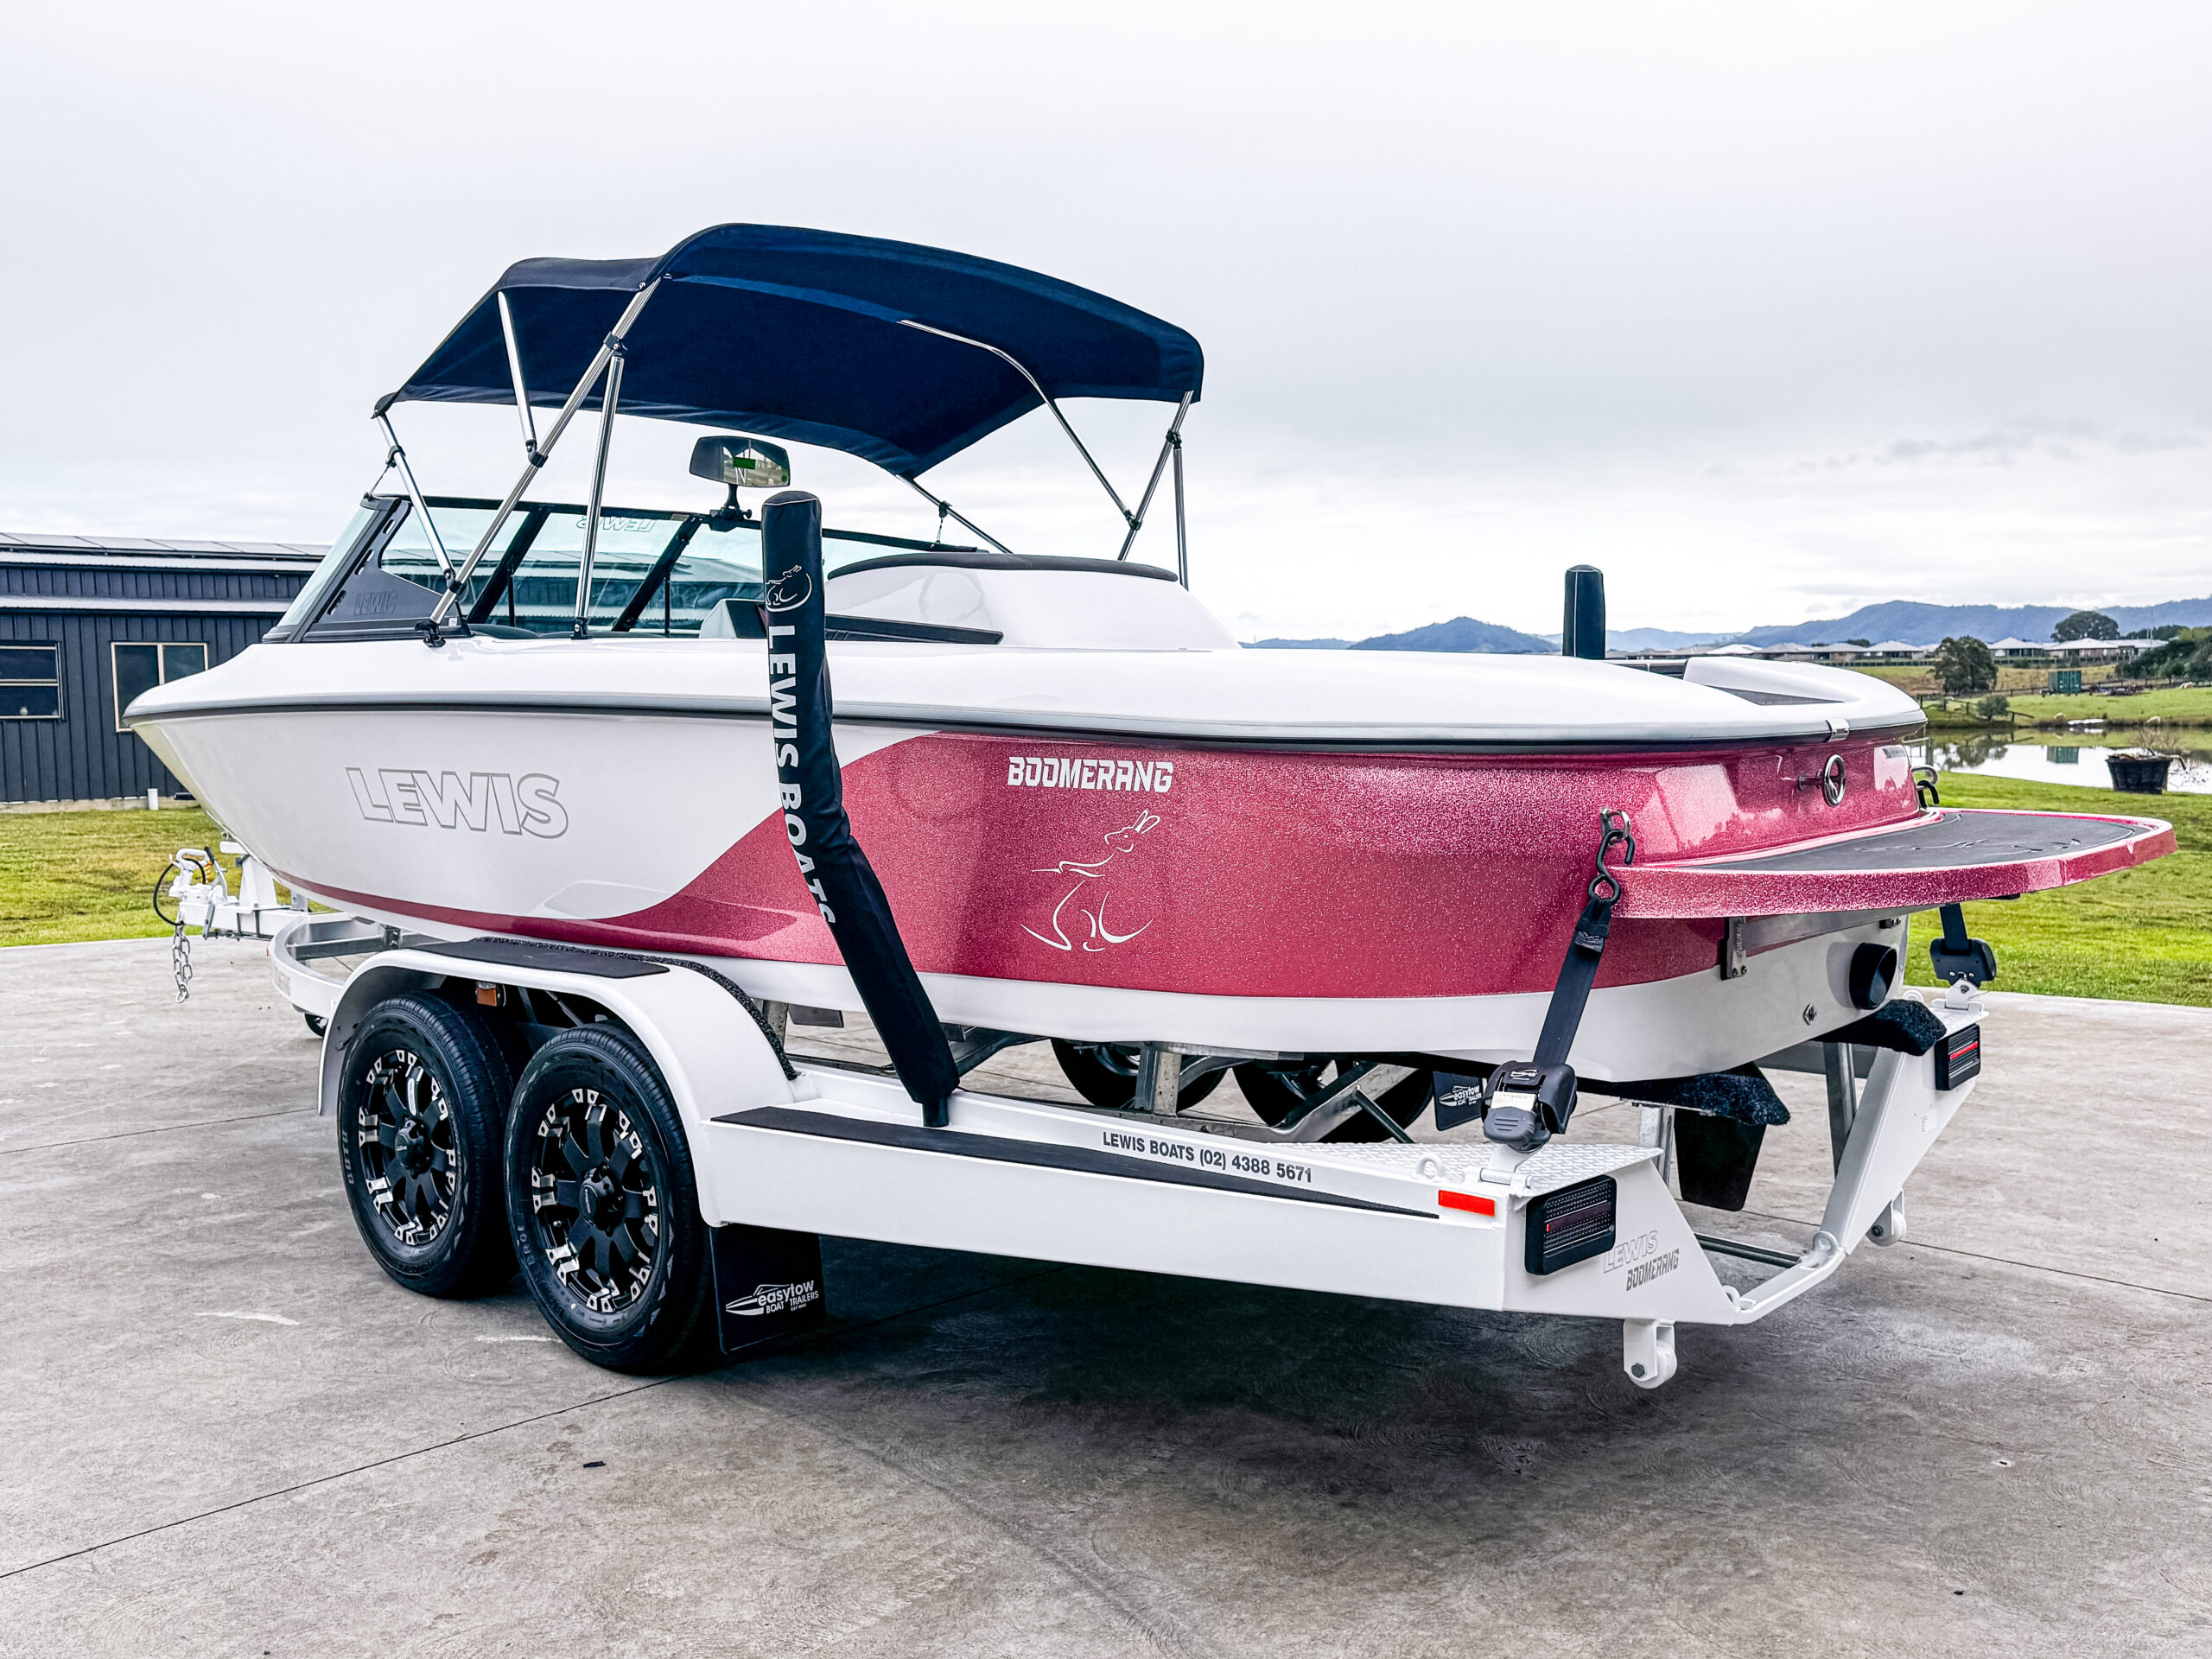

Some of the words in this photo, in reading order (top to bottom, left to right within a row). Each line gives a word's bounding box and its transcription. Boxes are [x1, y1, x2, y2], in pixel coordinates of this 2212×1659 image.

[353, 591, 397, 615] LEWIS
[768, 625, 799, 768] LEWIS
[1007, 756, 1174, 793] BOOMERANG
[345, 767, 569, 839] LEWIS
[1103, 1131, 1145, 1152] LEWIS
[1149, 1140, 1194, 1161] BOATS
[1199, 1148, 1226, 1170] (02)
[1231, 1154, 1271, 1175] 4388
[1276, 1163, 1312, 1183] 5671
[1603, 1230, 1658, 1274] LEWIS
[1626, 1249, 1680, 1291] BOOMERANG
[758, 1280, 815, 1306] easytow
[766, 1301, 785, 1314] BOAT
[789, 1290, 819, 1306] TRAILERS
